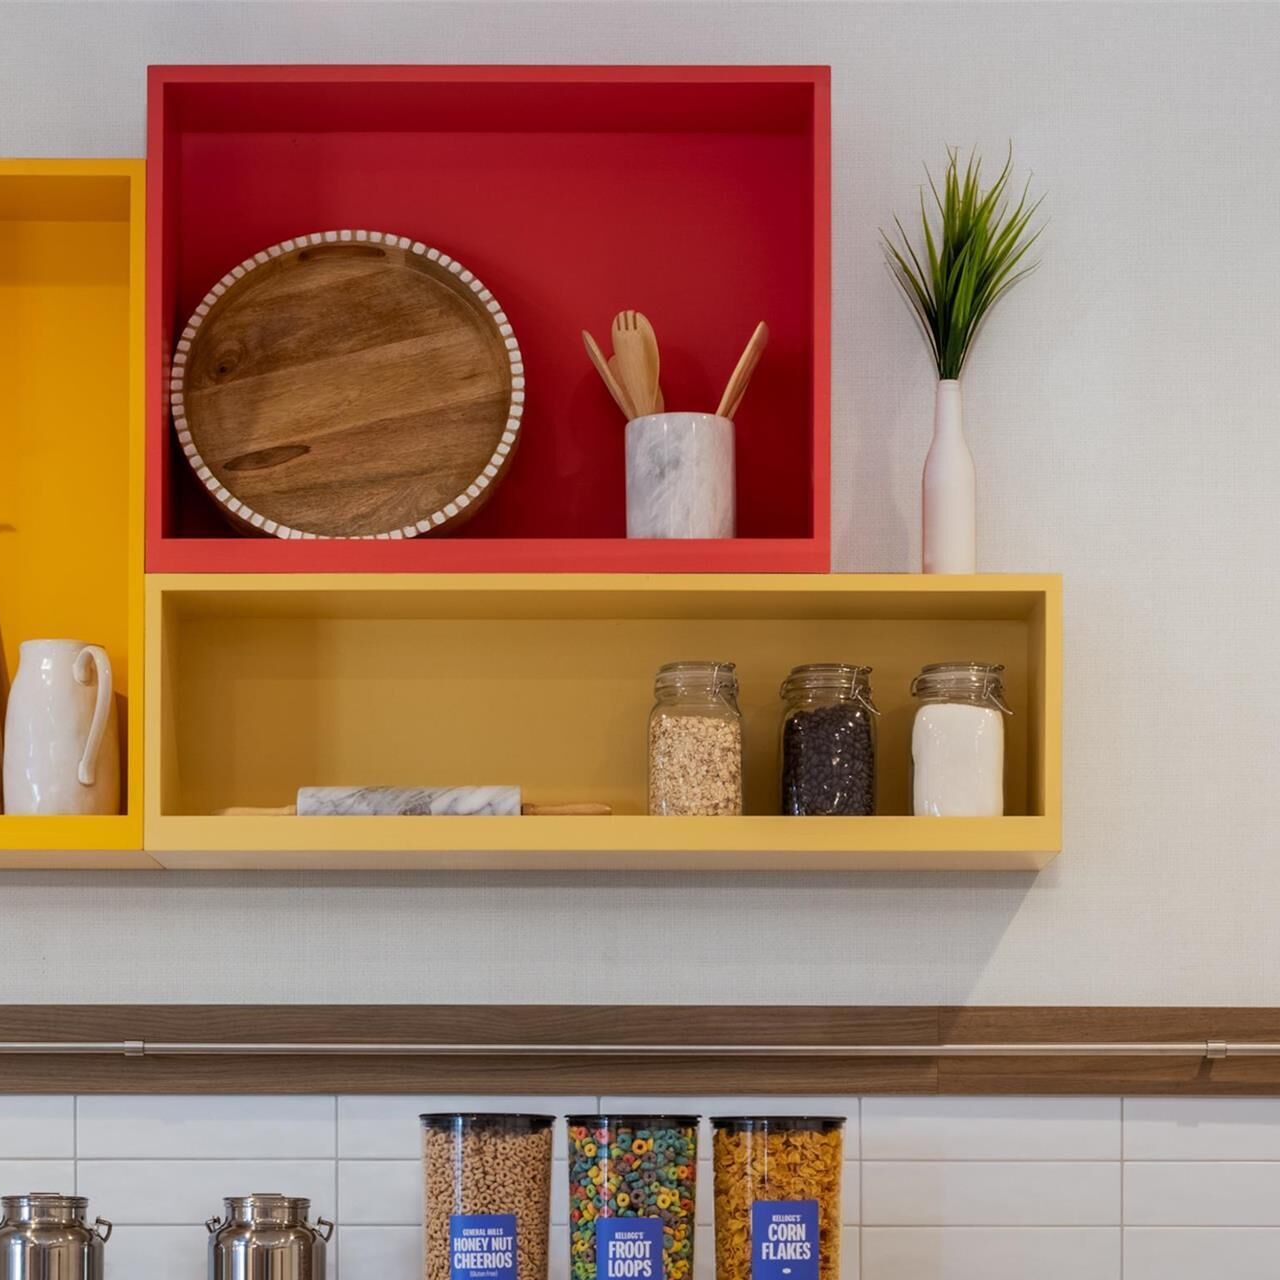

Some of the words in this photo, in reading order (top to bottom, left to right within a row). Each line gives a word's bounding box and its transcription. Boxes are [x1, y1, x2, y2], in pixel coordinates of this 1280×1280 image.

[462, 1228, 486, 1236] GENERAL
[487, 1228, 503, 1236] MILLS
[768, 1223, 806, 1241] CORN
[454, 1237, 489, 1251] HONEY
[491, 1236, 513, 1251] NUT
[608, 1241, 652, 1258] FROOT
[761, 1242, 811, 1260] FLAKES
[454, 1252, 513, 1269] CHEERIOS
[608, 1260, 652, 1277] LOOPS
